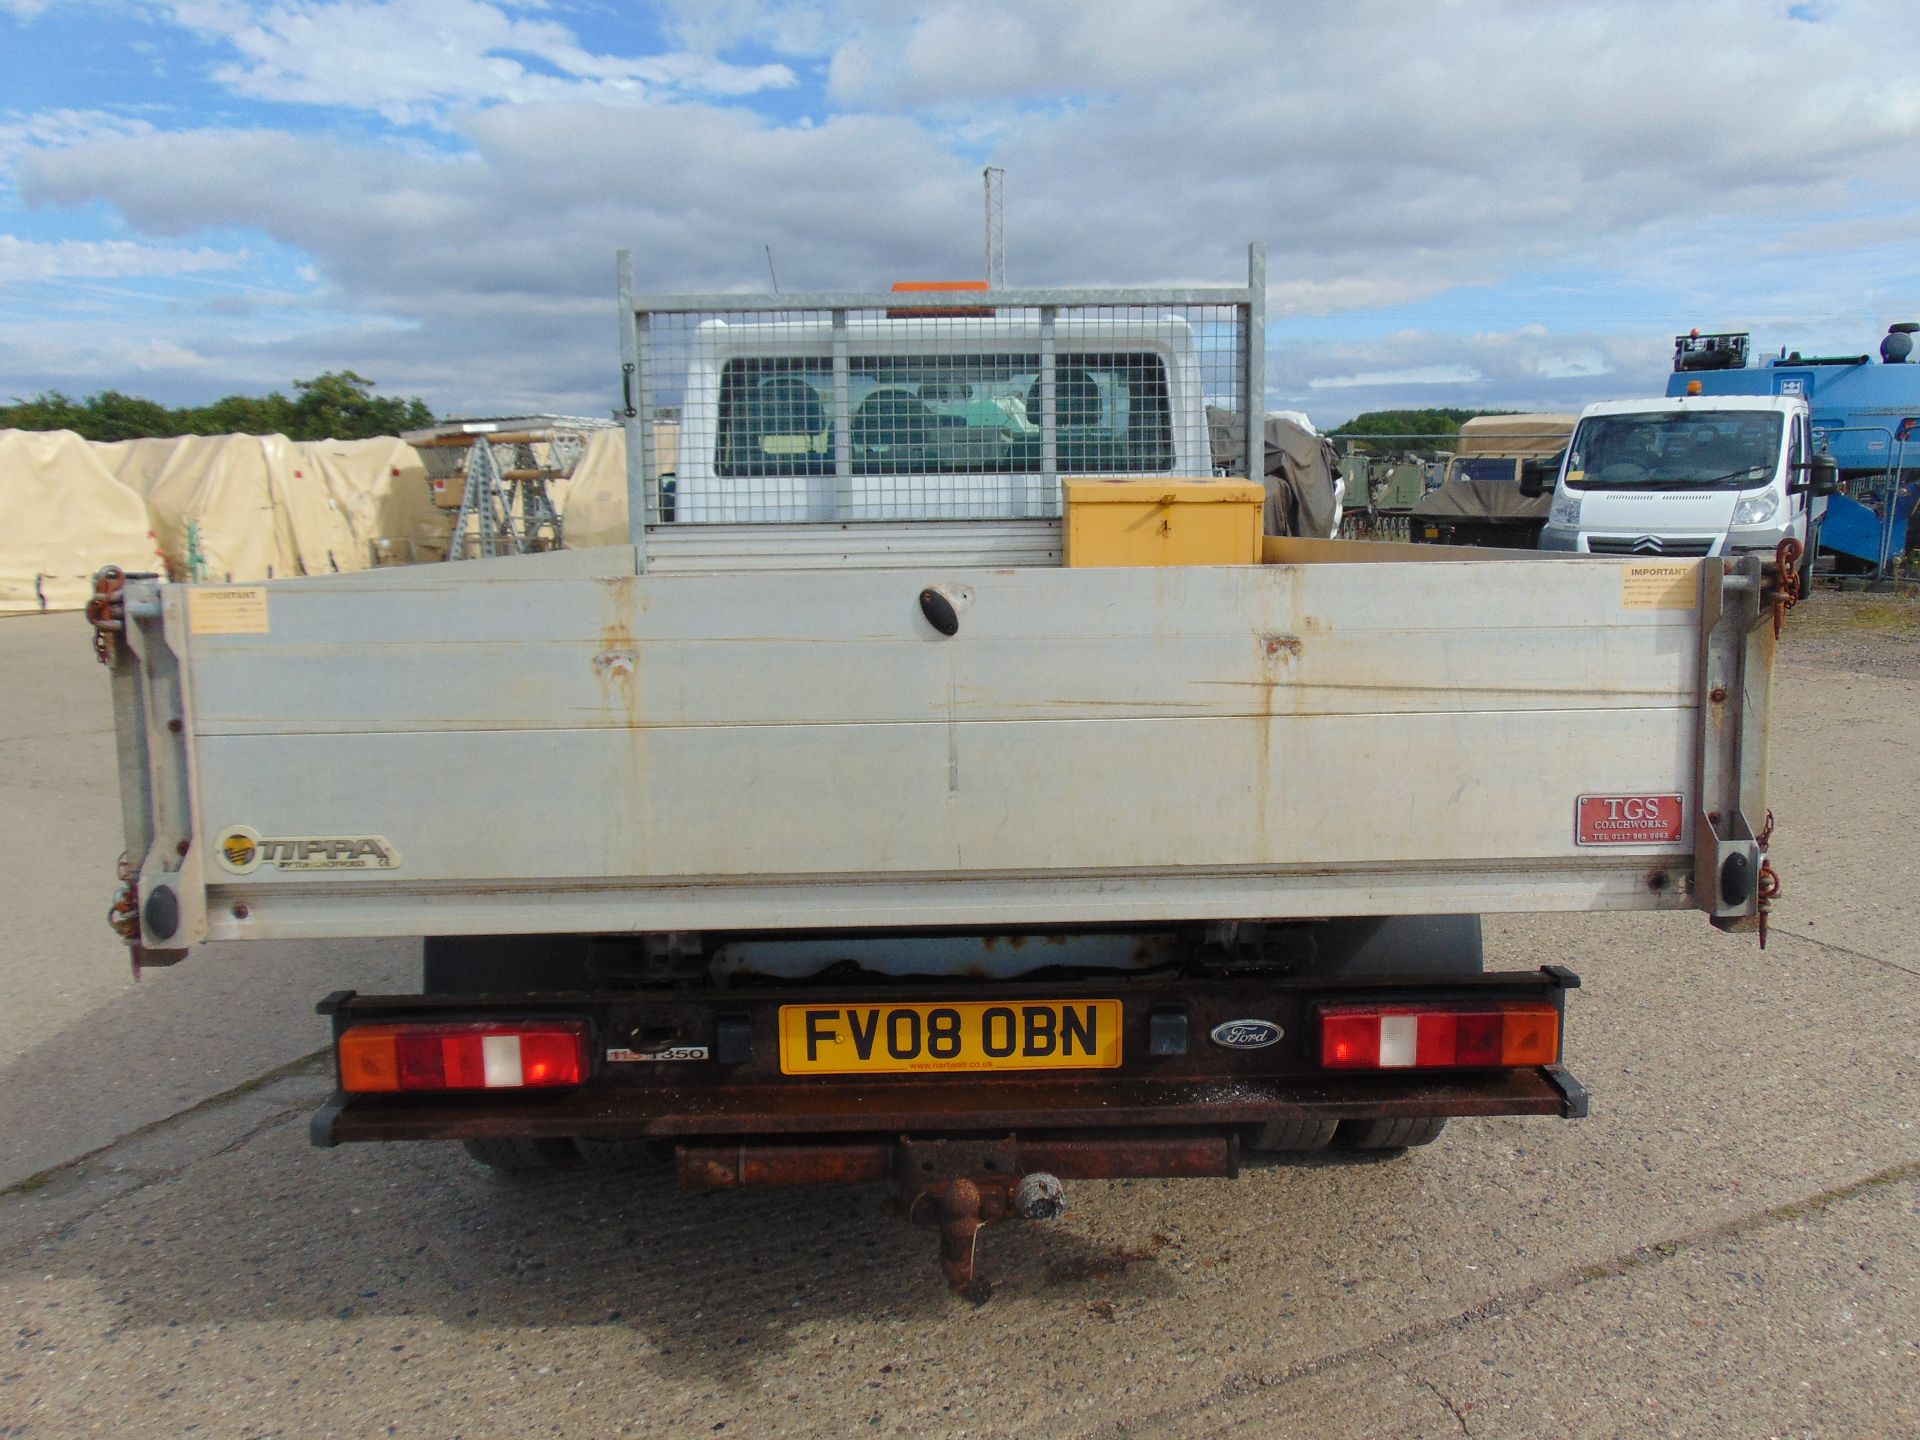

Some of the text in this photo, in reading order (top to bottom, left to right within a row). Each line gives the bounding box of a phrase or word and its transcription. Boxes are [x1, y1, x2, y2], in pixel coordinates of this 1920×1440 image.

[1631, 568, 1688, 576] IMPORTANT
[1604, 797, 1659, 820] TGS
[1594, 820, 1668, 829] COACHWORKS
[1593, 833, 1609, 841] TEL
[256, 838, 388, 861] TIPPA
[805, 1005, 1098, 1061] FV08 OBN
[1226, 1026, 1268, 1043] Ford
[909, 1060, 993, 1071] www.hartwell.co.uk
